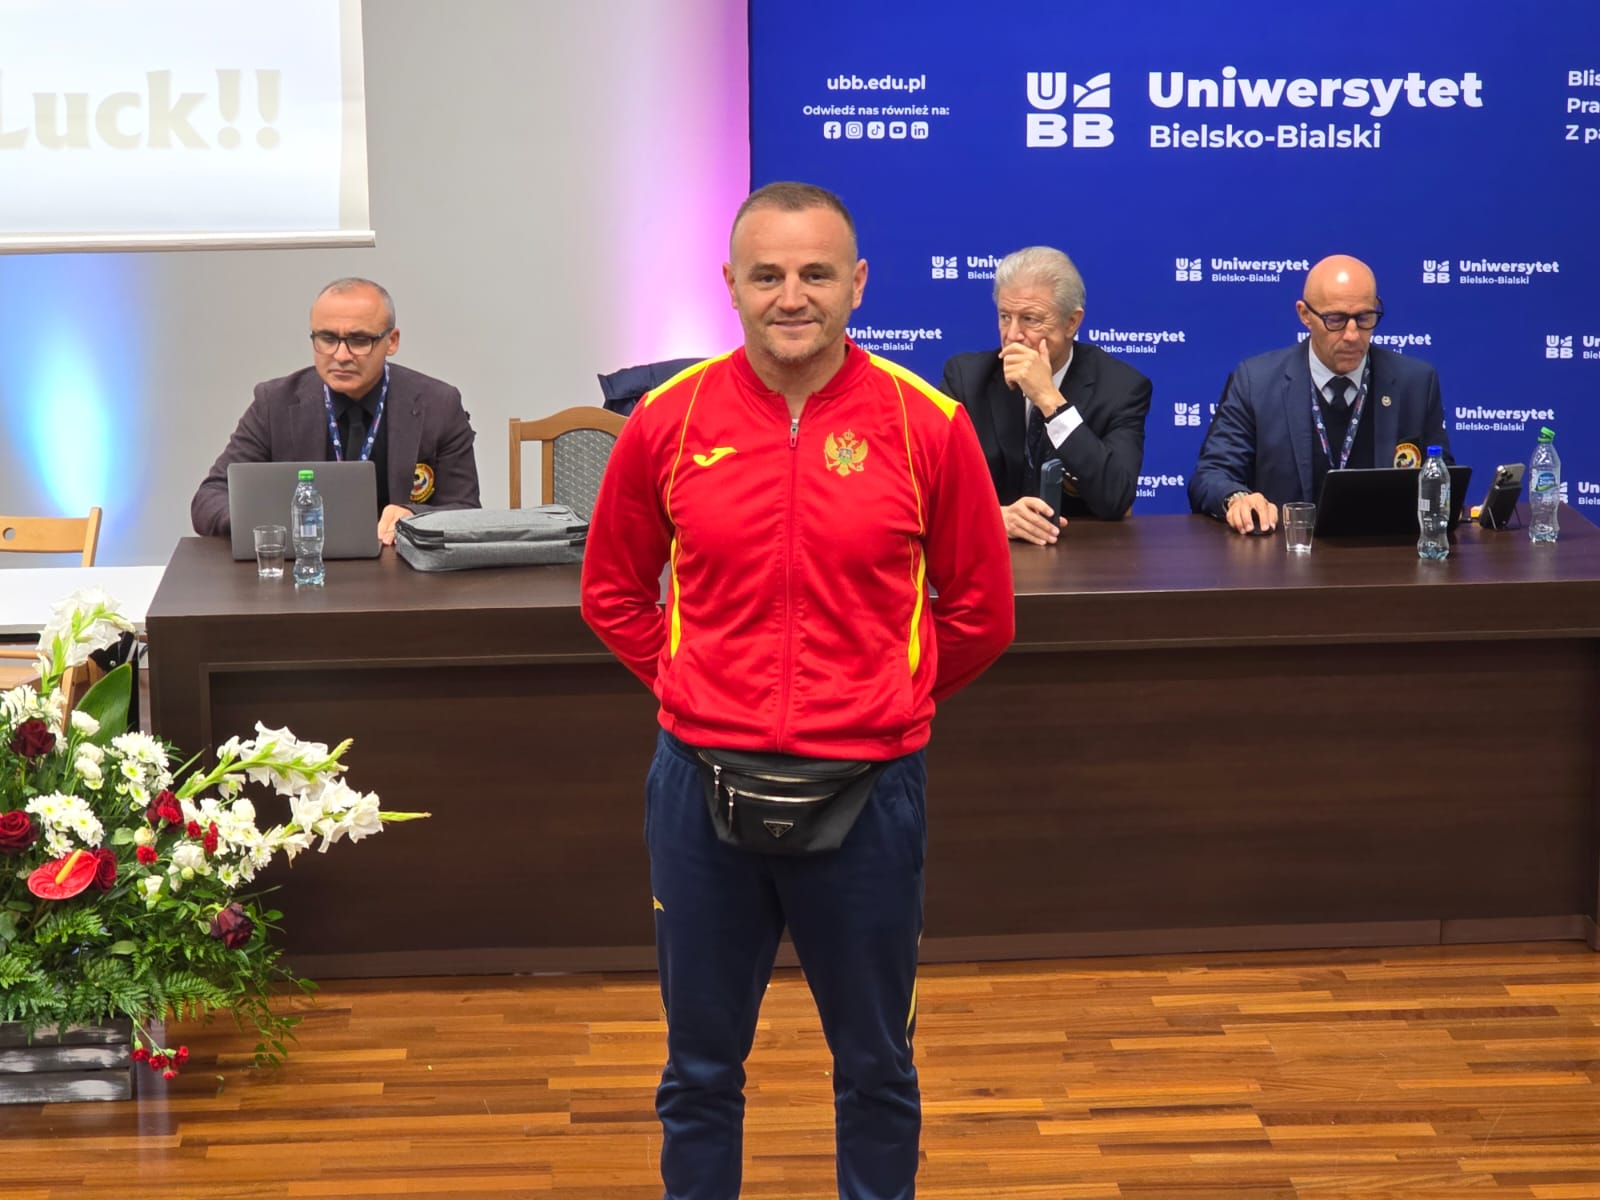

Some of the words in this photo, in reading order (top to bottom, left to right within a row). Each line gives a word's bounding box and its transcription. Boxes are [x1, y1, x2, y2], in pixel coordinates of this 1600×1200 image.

[827, 74, 926, 94] ubb.edu.pl
[1148, 65, 1484, 117] Uniwersytet
[802, 104, 856, 116] Odwiedź
[858, 107, 880, 116] nas
[882, 104, 929, 116] również
[931, 106, 950, 116] na:
[1567, 97, 1600, 114] Pra
[1150, 123, 1381, 149] Bielsko-Bialski
[1565, 124, 1580, 141] Z
[1584, 126, 1600, 144] p
[1211, 256, 1310, 273] Uniwersytet
[1459, 258, 1560, 275] Uniwersytet
[1211, 273, 1280, 282] Bielsko-Bialski
[1459, 275, 1530, 285] Bielsko-Bialski
[845, 325, 943, 342] Uniwersytet
[1088, 328, 1186, 345] Uniwersytet
[857, 342, 914, 351] lsko-Bialski
[1100, 344, 1157, 354] lsko-Bialski
[1455, 406, 1555, 422] Uniwersytet
[1455, 421, 1525, 431] Bielsko-Bialski
